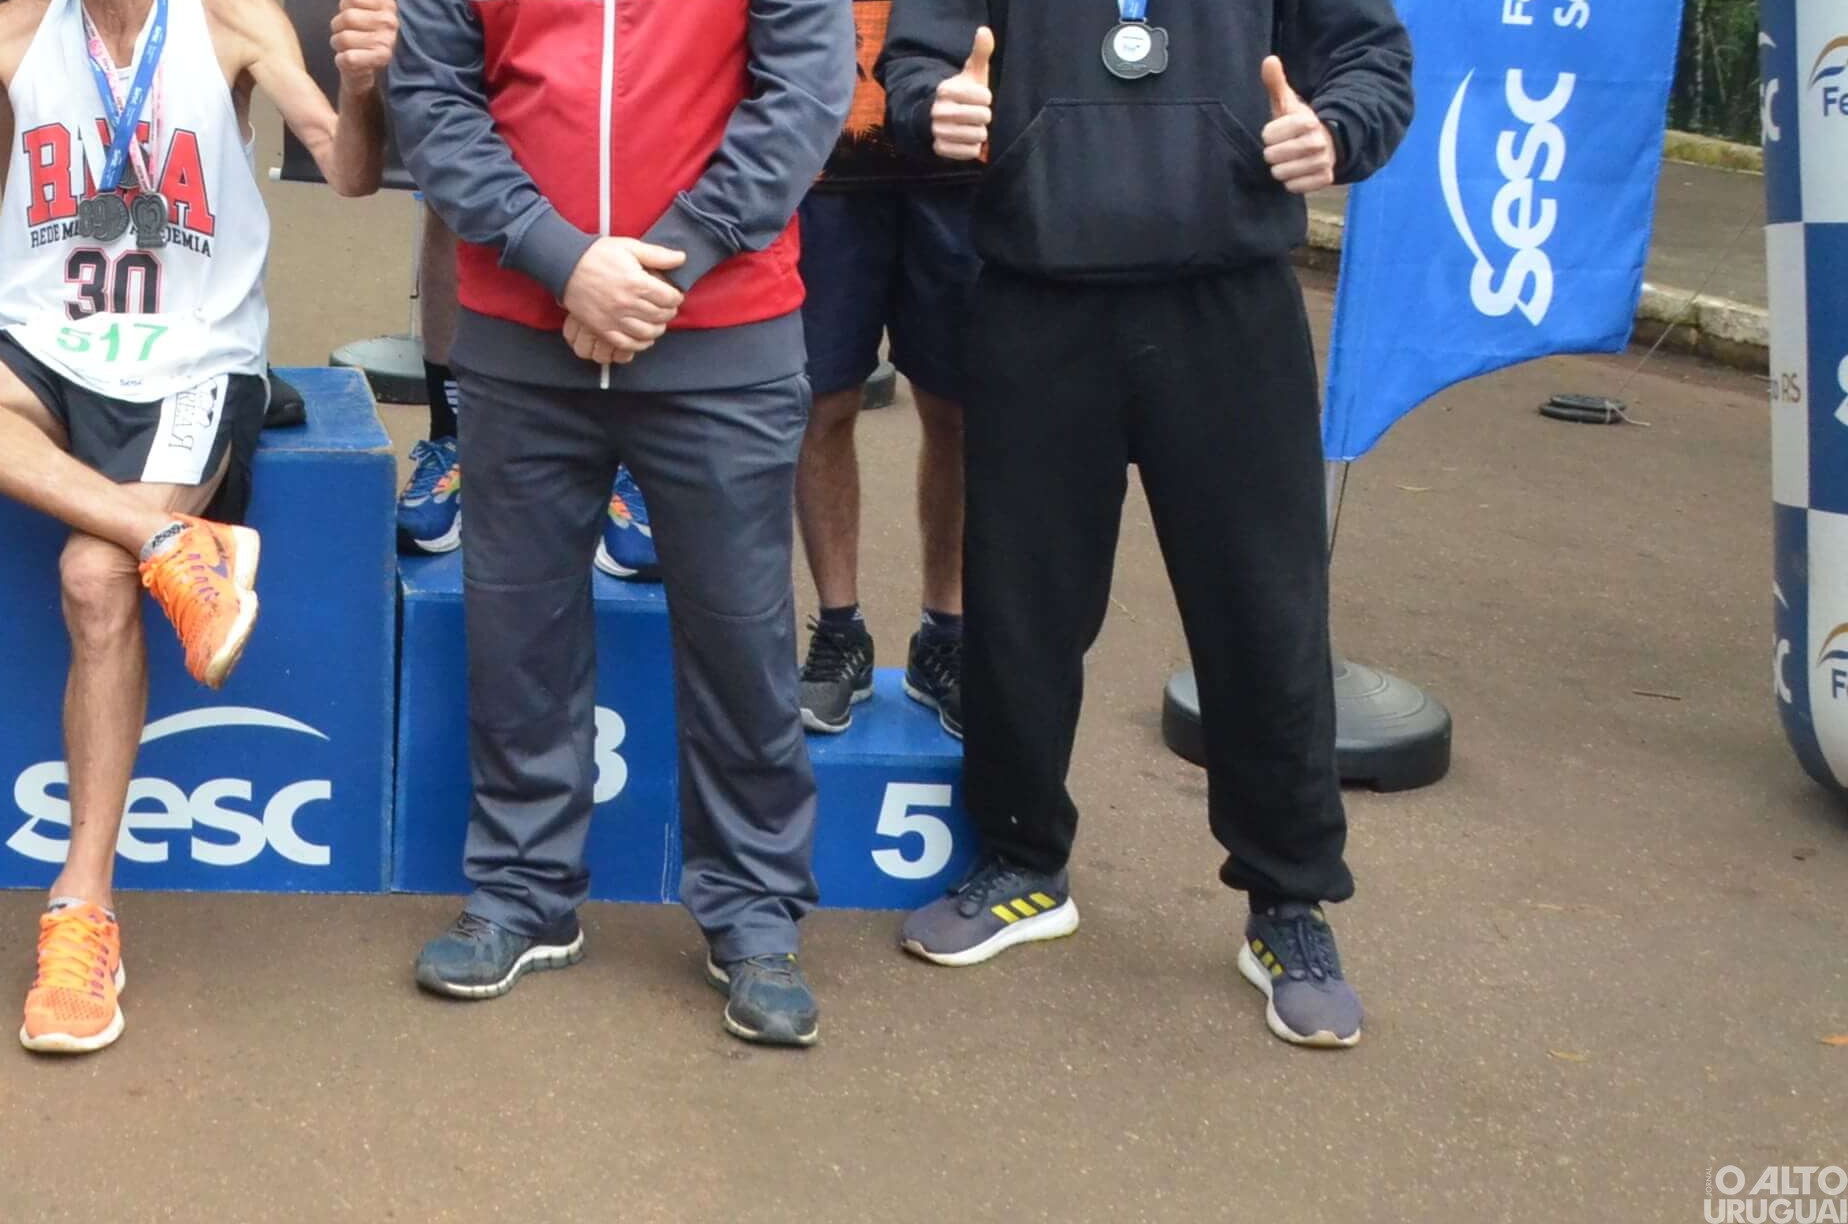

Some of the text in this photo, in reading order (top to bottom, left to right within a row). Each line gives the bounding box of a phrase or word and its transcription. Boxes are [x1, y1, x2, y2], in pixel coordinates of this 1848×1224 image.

[30, 224, 59, 249] REDE
[64, 247, 162, 321] 30
[56, 322, 169, 362] 517
[871, 782, 953, 879] 5
